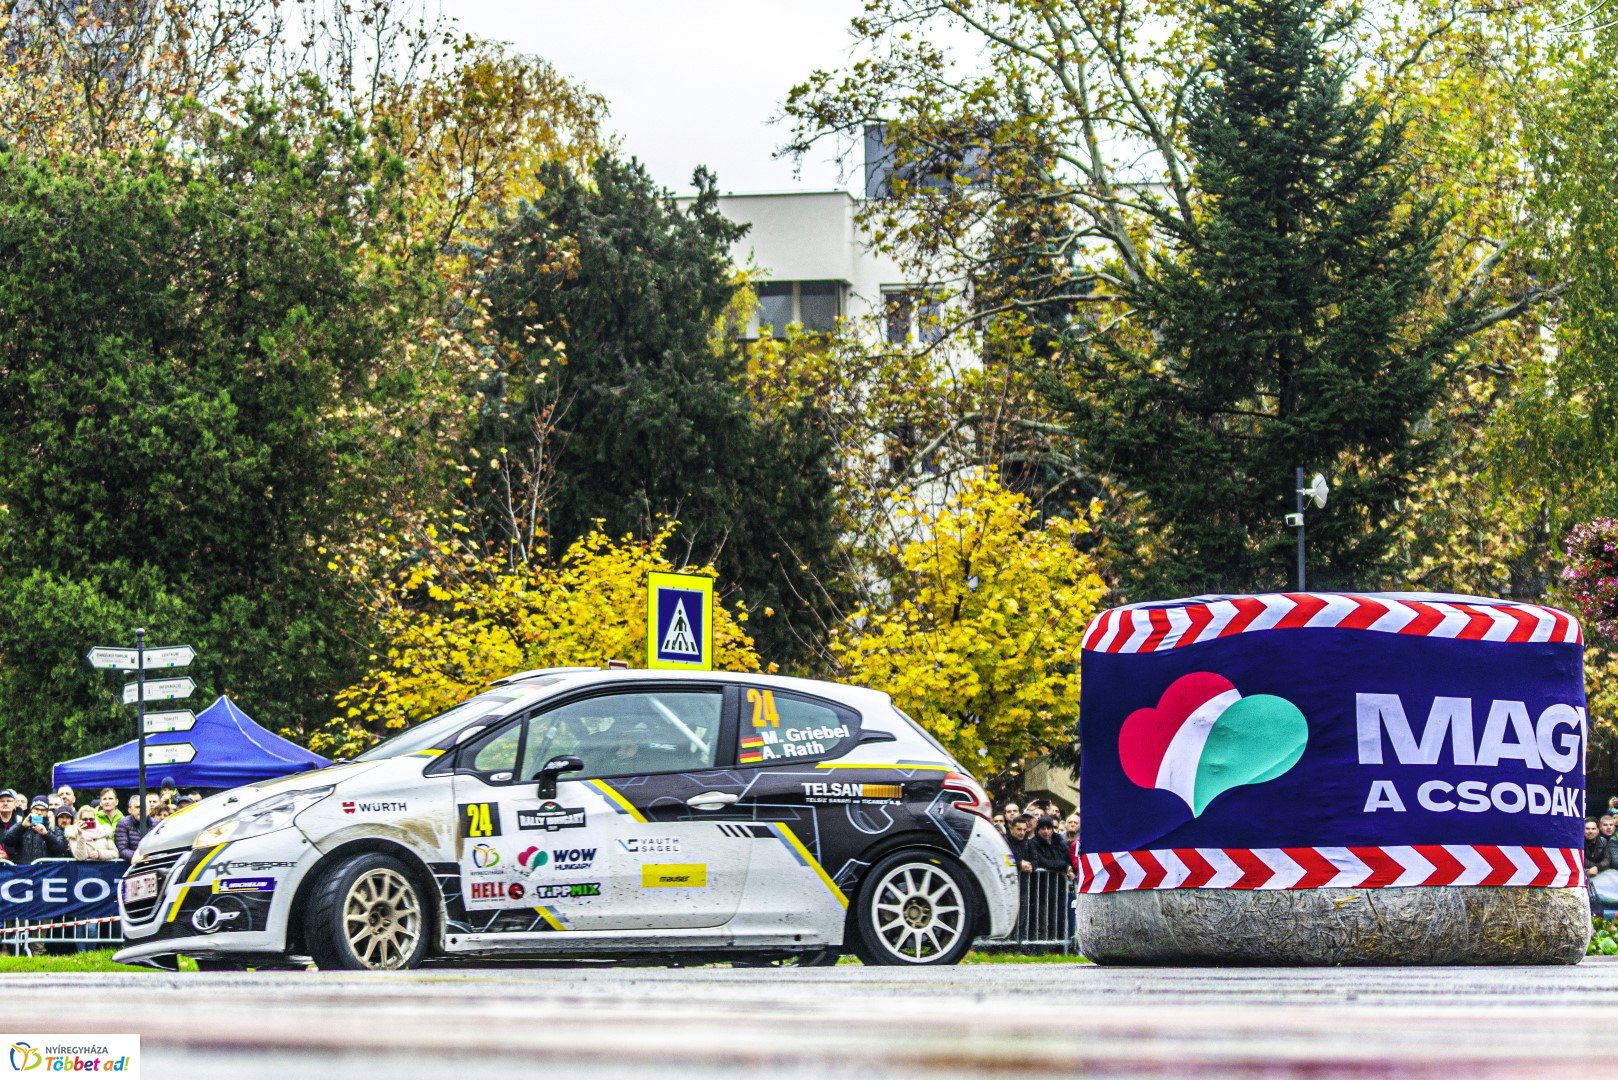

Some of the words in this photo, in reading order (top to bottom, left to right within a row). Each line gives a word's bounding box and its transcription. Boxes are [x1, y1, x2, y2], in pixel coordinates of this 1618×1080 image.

[746, 688, 780, 728] 24
[762, 730, 784, 744] M.
[786, 725, 850, 742] Griebel
[762, 746, 781, 760] A.
[783, 741, 825, 754] Rath
[801, 782, 864, 797] TELSAN
[1363, 780, 1407, 813] A
[1416, 775, 1581, 818] CSODÁK
[358, 801, 407, 812] WÜRTH
[466, 803, 493, 837] 24
[552, 848, 597, 862] WOW
[554, 863, 592, 871] HUNGARY
[0, 877, 124, 903] GEO
[229, 881, 268, 889] MICHELIN
[471, 882, 506, 900] HELL
